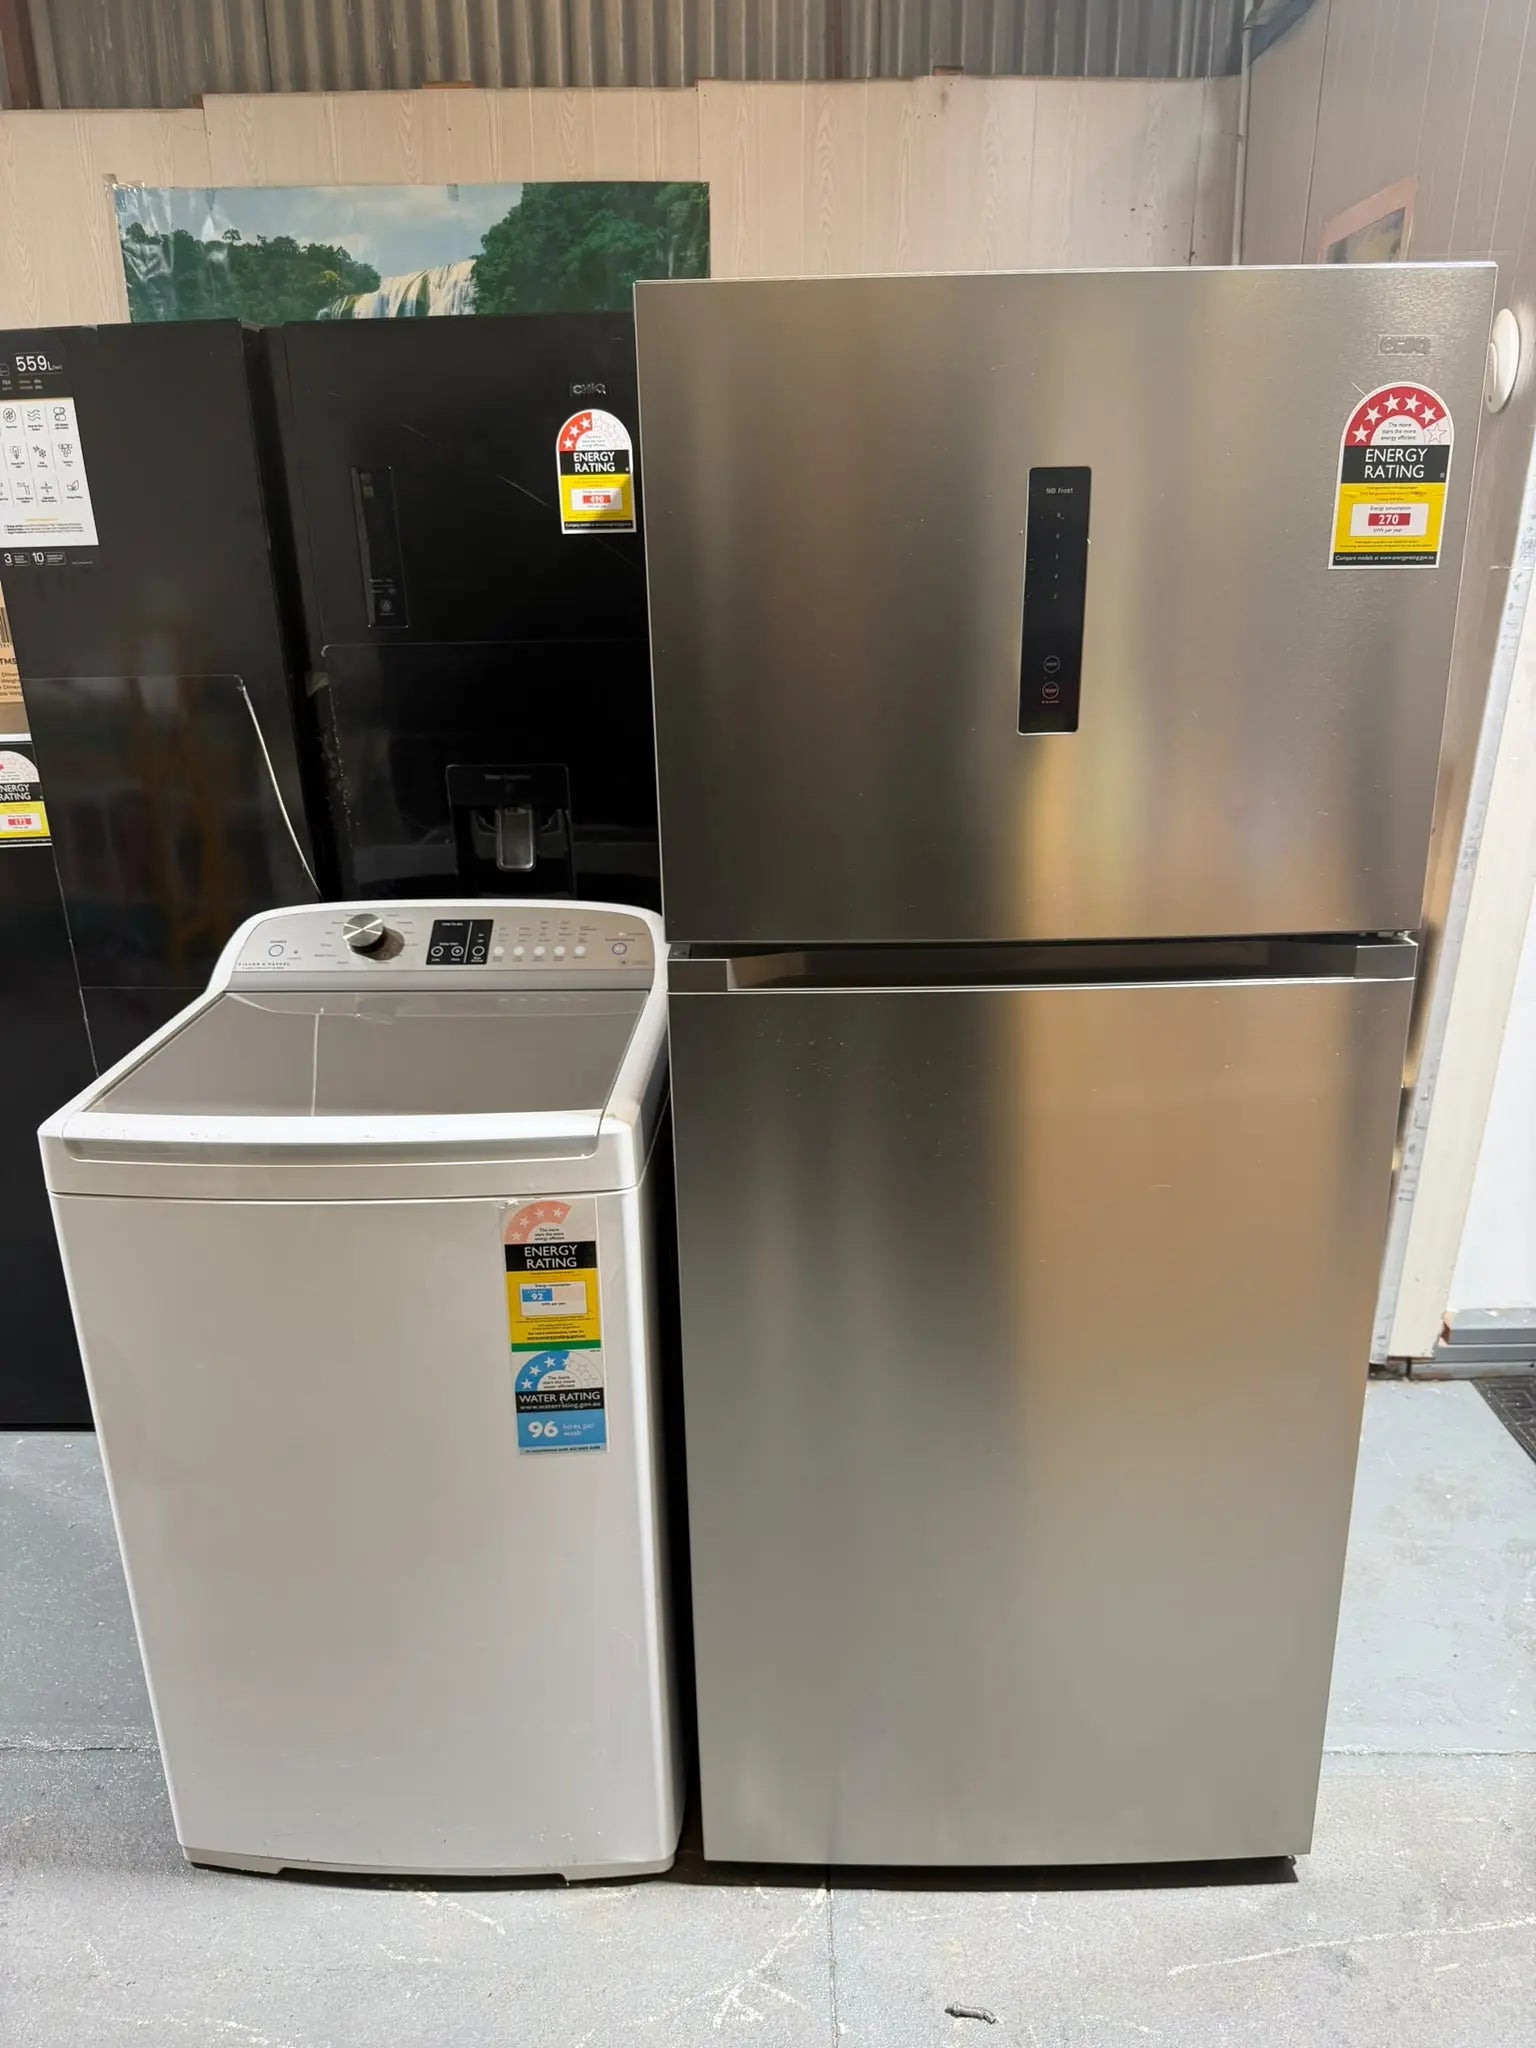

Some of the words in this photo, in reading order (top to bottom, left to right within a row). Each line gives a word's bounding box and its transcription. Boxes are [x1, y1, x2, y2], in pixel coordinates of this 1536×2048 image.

[573, 451, 616, 462] ENERGY
[1365, 448, 1428, 463] ENERGY
[574, 462, 616, 473] RATING
[1364, 464, 1425, 479] RATING
[1378, 514, 1399, 525] 270
[4, 552, 12, 564] 3
[32, 552, 45, 563] 10
[0, 783, 30, 793] NERGY
[524, 1244, 578, 1257] ENERGY
[526, 1257, 577, 1269] RATING
[519, 1393, 557, 1403] WATER
[559, 1391, 601, 1403] RATING
[527, 1420, 559, 1438] 96
